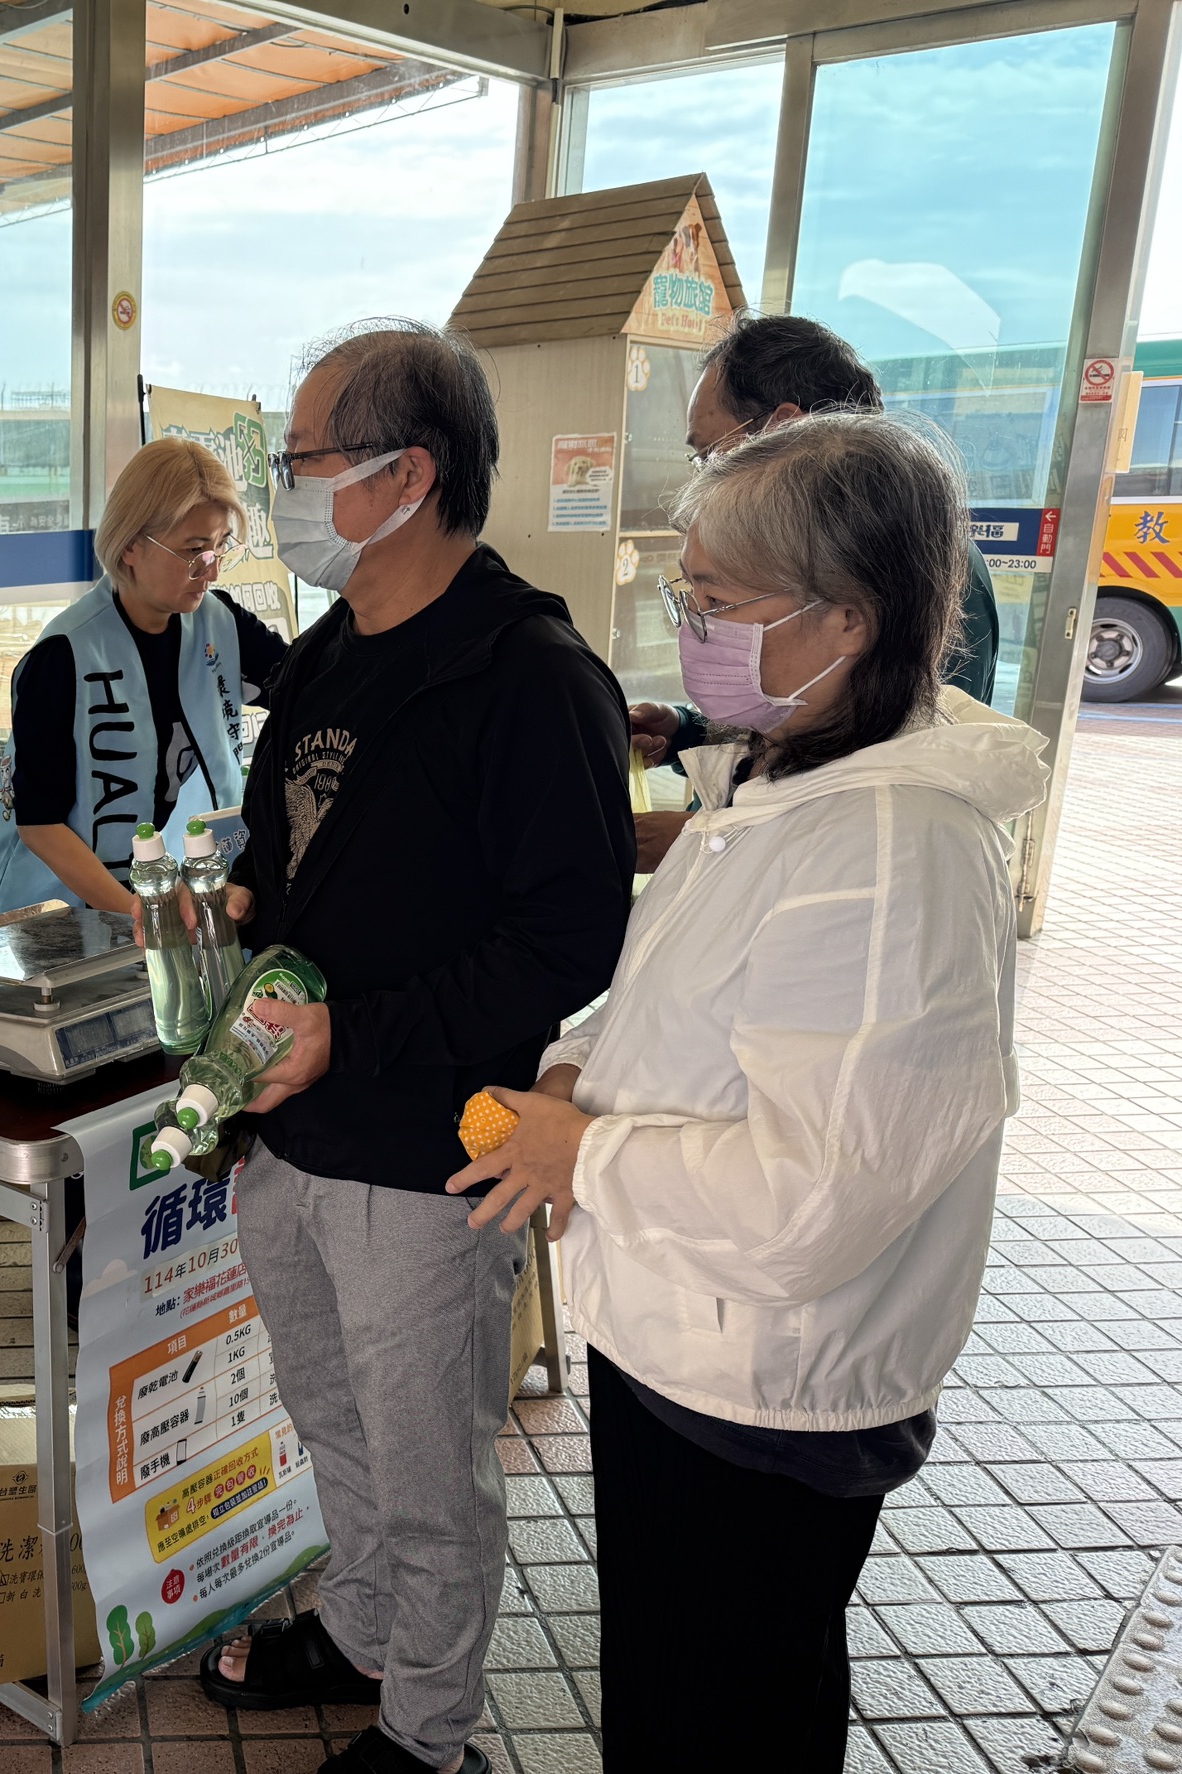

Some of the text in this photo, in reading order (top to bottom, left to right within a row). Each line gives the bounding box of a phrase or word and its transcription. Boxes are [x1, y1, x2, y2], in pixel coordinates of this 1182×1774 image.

[653, 273, 714, 317] 寵物旅館
[1040, 523, 1054, 554] 自動門
[1133, 510, 1171, 544] 教
[167, 1304, 247, 1355] 項目 數量
[226, 1323, 252, 1346] 0.5KG
[137, 1346, 246, 1400] 廢乾電池 1KG
[230, 1367, 246, 1385] 2個
[139, 1388, 249, 1446] 廢高壓容器 10個
[114, 1396, 129, 1485] 兌換方式說明
[139, 1452, 171, 1481] 廢手機
